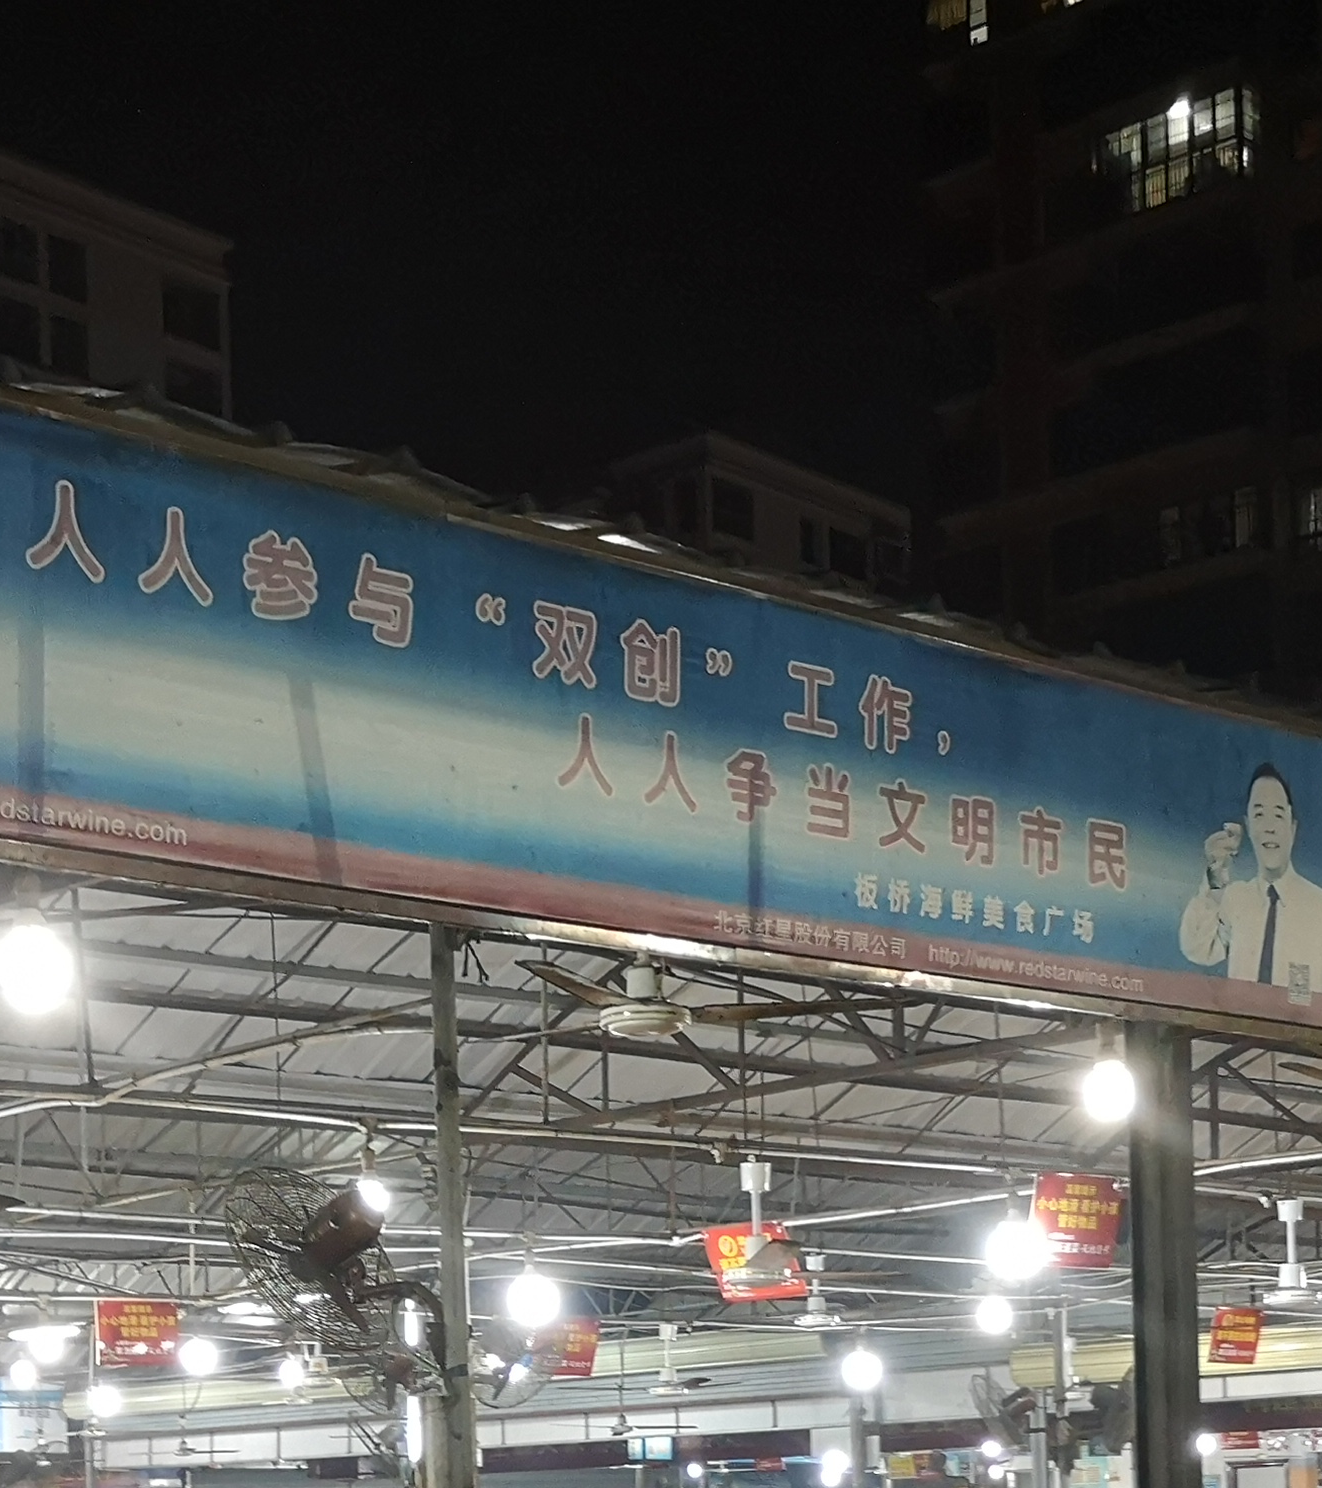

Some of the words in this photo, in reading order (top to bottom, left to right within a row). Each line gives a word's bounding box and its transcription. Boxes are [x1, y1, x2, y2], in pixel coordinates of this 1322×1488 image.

[558, 712, 1131, 890] 人人争当文明市民
[714, 909, 907, 960] 北京红星股份有限公司
[854, 871, 1095, 943] 板桥海鲜美食广场
